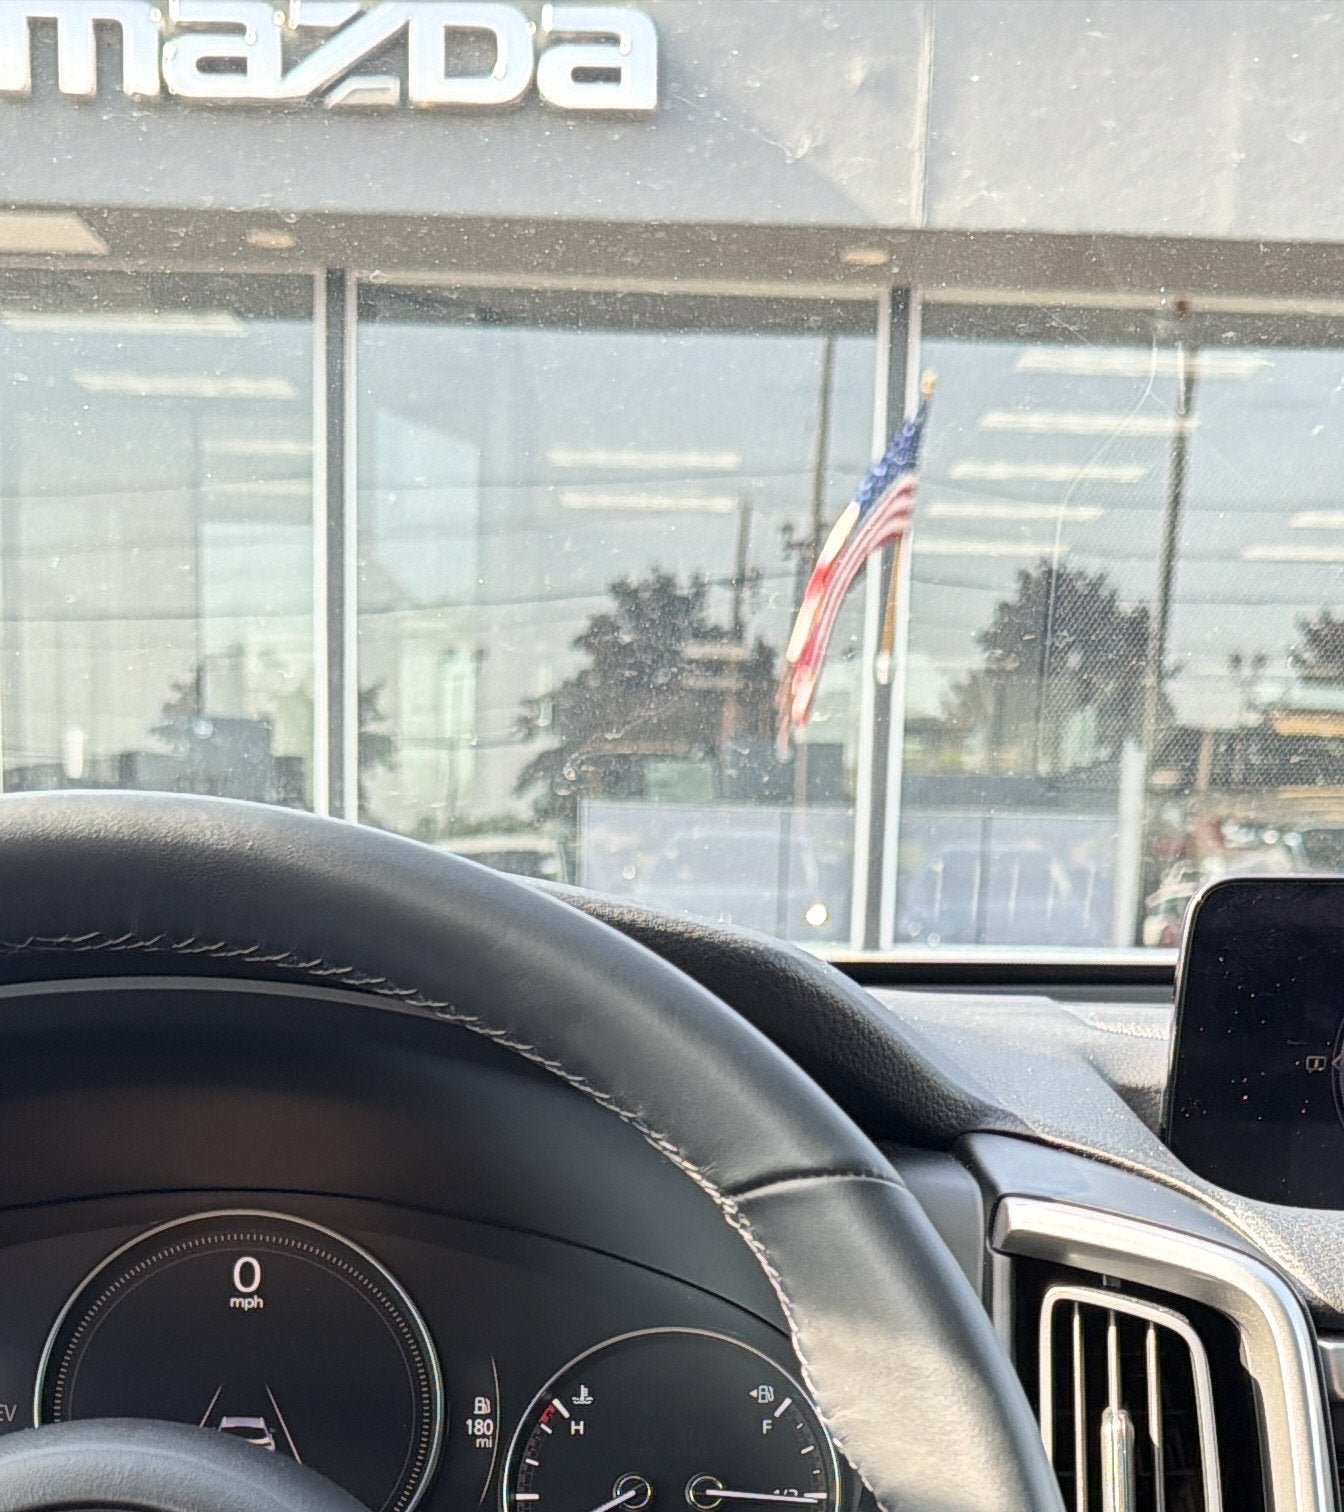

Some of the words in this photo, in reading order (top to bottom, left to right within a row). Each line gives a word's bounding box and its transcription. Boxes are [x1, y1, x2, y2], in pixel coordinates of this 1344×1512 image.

[233, 1256, 261, 1294] 0
[229, 1295, 264, 1311] mph
[465, 1418, 494, 1436] 180
[570, 1420, 584, 1435] H
[762, 1419, 773, 1435] F
[475, 1436, 493, 1450] mi
